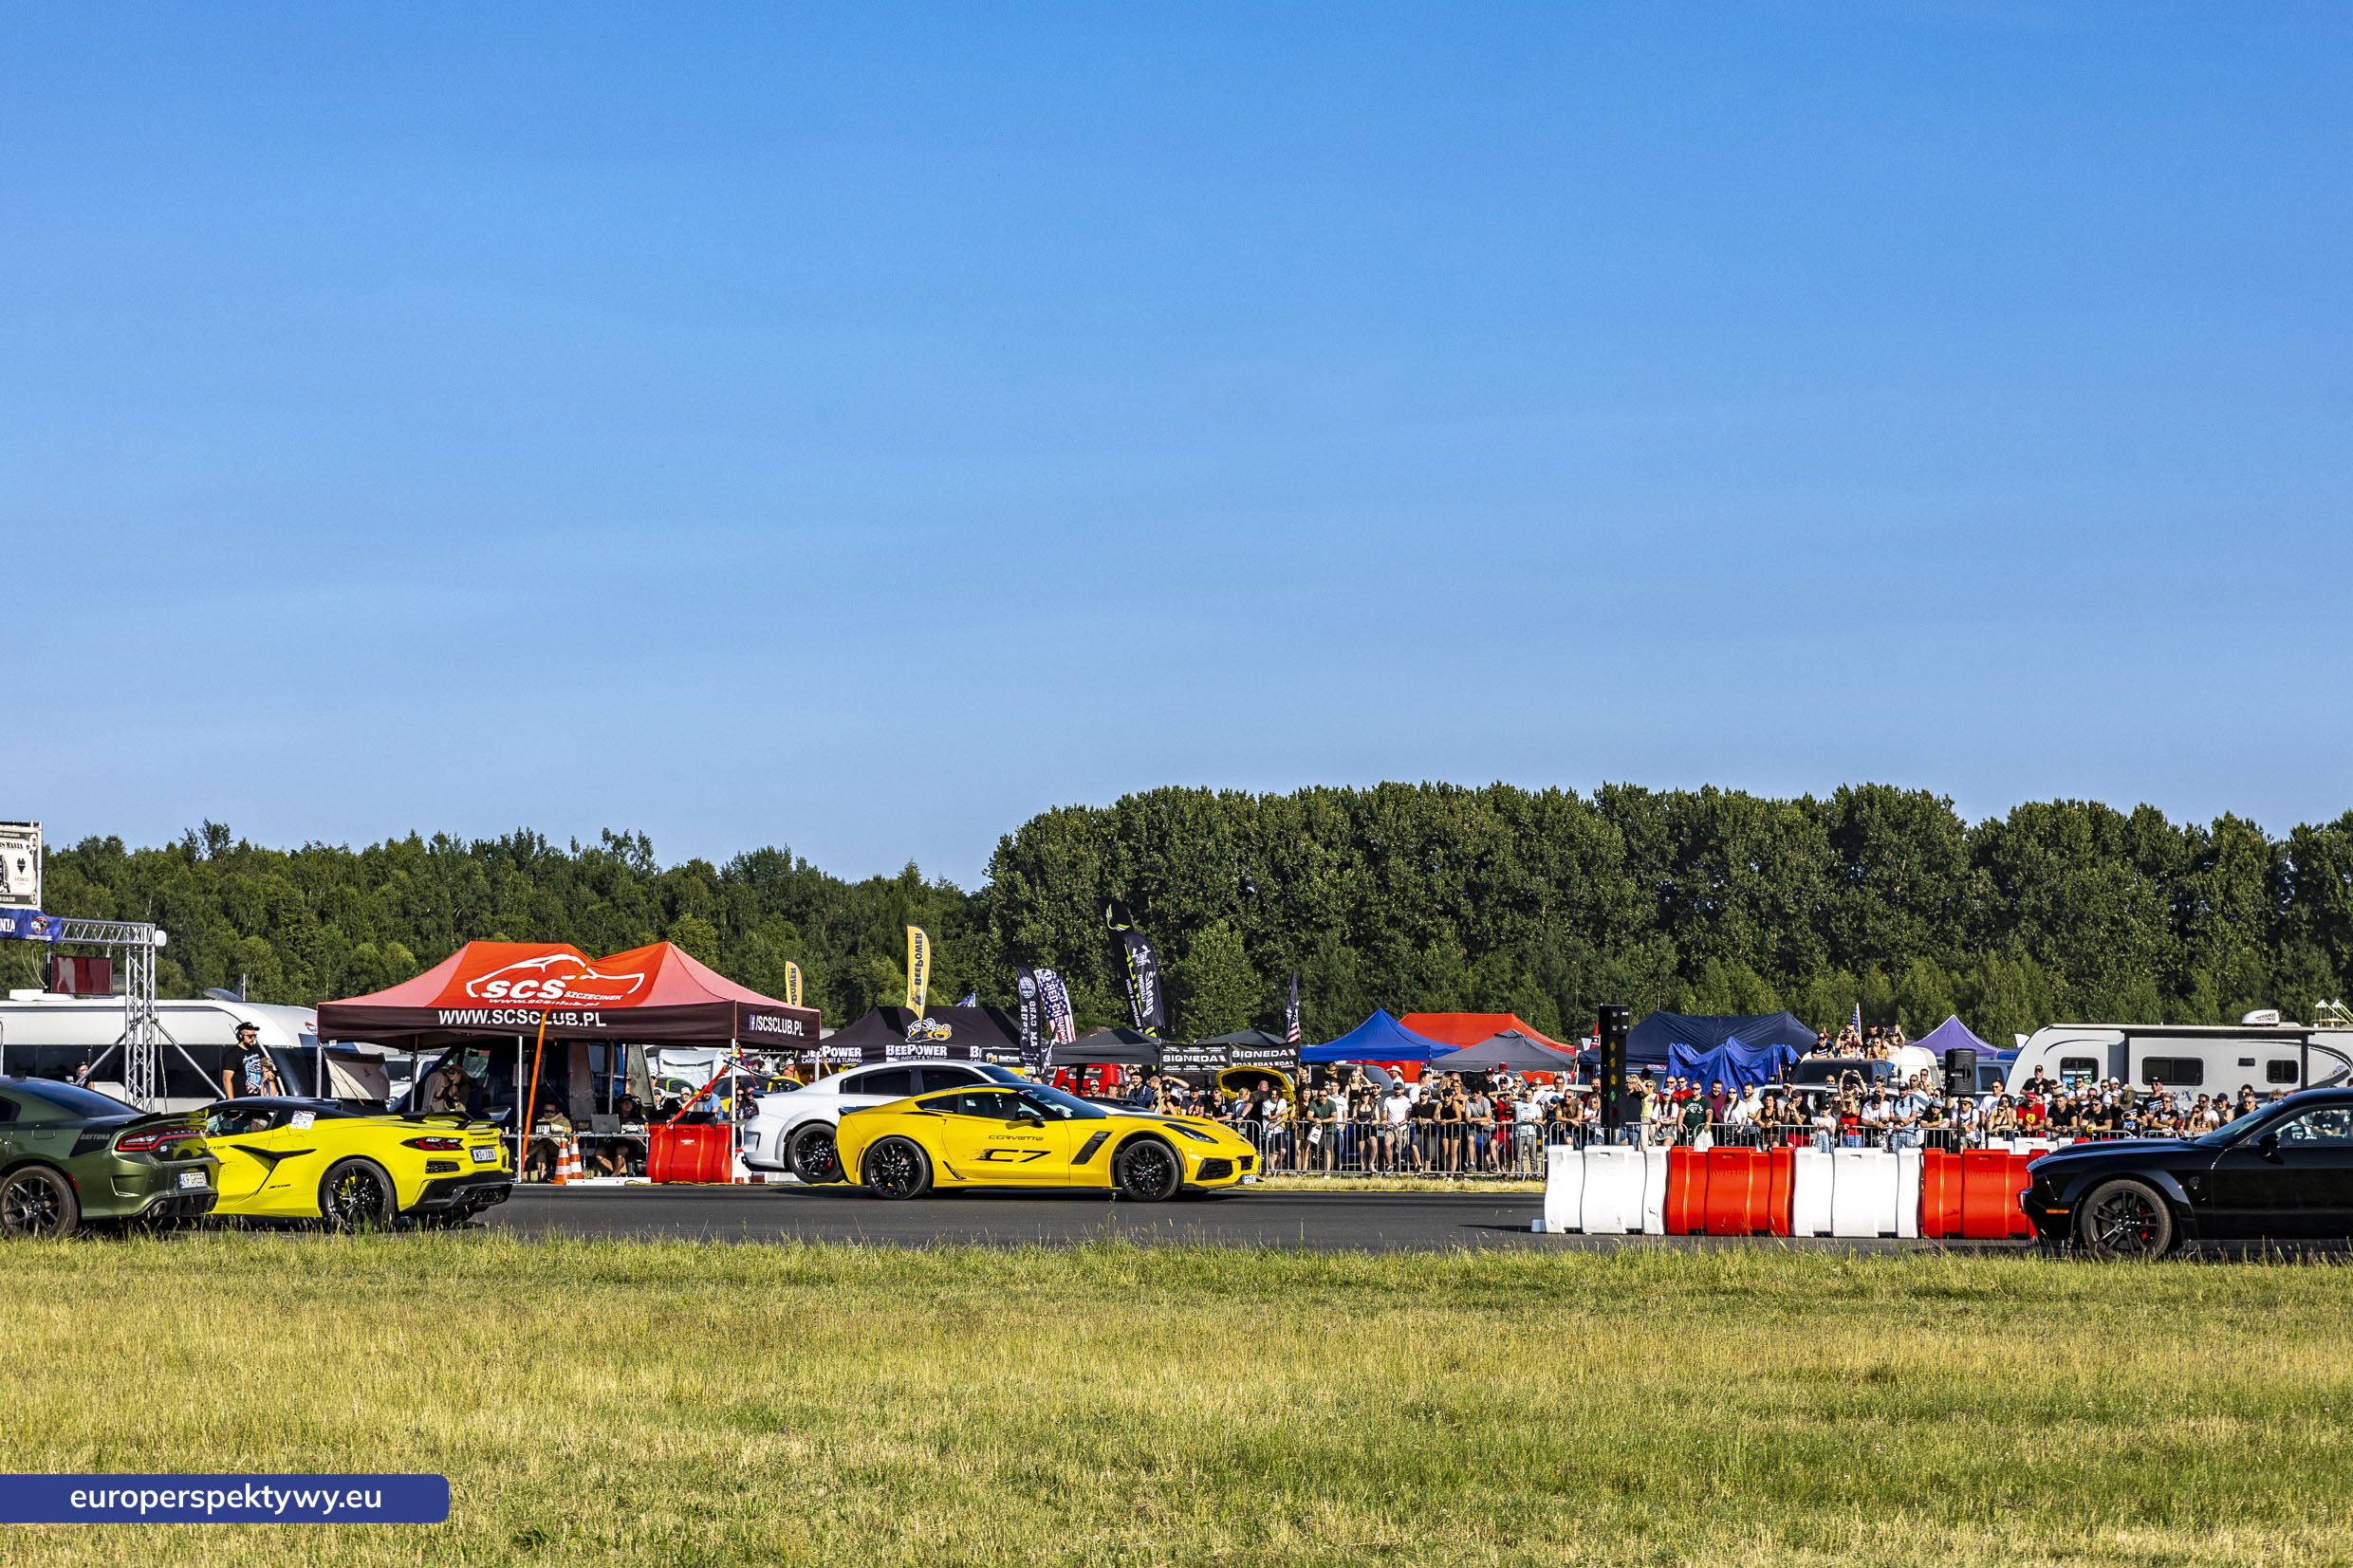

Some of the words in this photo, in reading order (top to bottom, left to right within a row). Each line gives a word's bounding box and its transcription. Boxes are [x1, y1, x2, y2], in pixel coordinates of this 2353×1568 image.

[0, 918, 15, 932] NIA
[480, 978, 567, 1000] SCS
[565, 989, 623, 1001] SZCZECINEK
[1046, 982, 1059, 1004] RED
[1162, 1054, 1219, 1063] SIGNEDA
[1232, 1048, 1288, 1059] SIGNEDA
[975, 1148, 1052, 1163] C7
